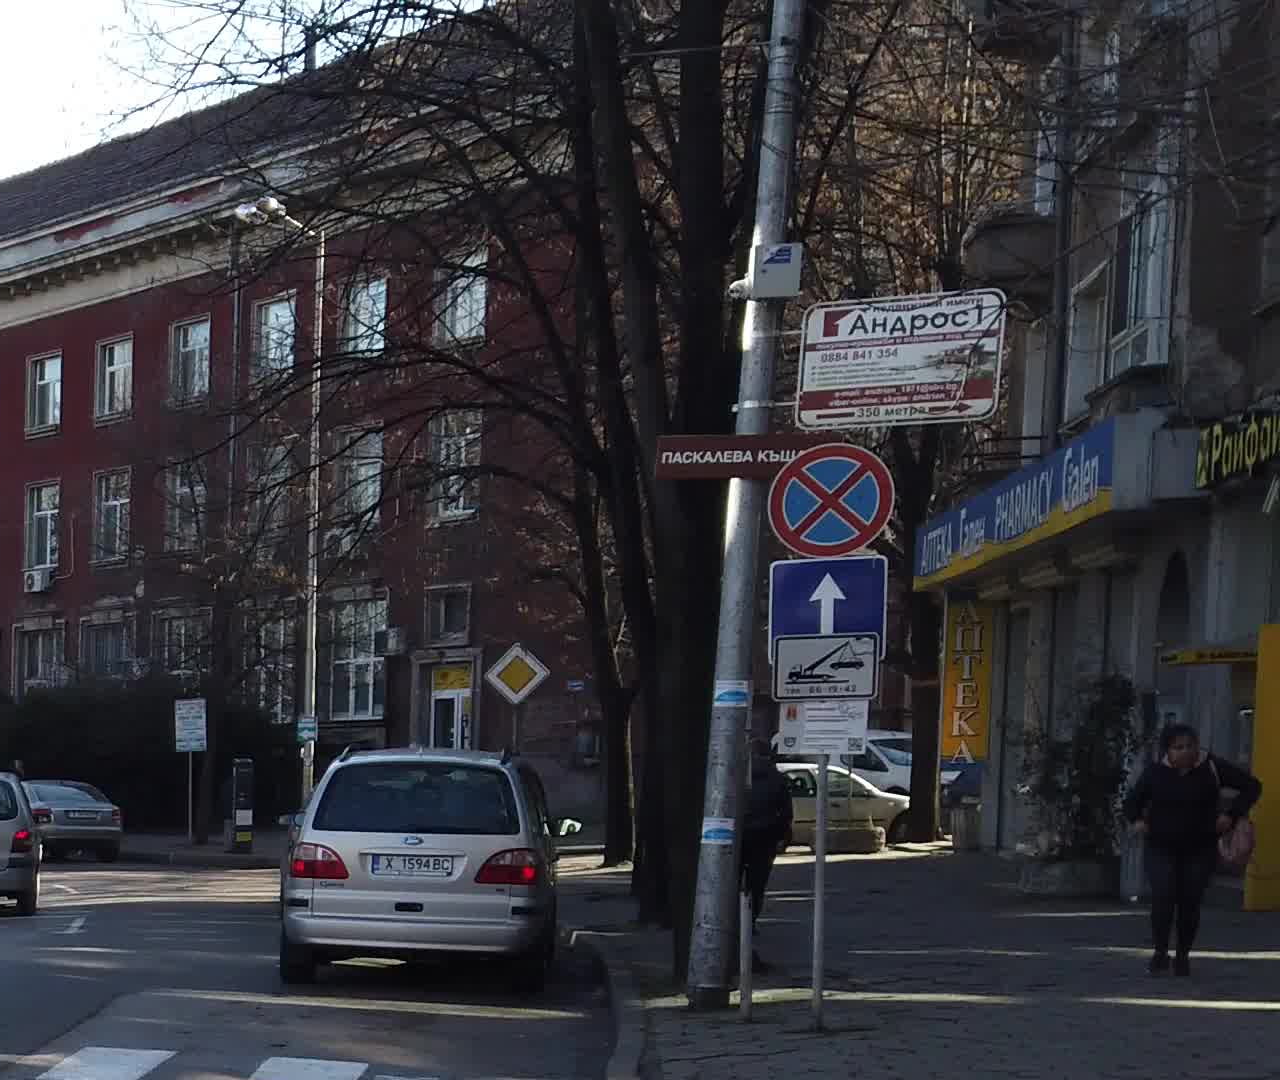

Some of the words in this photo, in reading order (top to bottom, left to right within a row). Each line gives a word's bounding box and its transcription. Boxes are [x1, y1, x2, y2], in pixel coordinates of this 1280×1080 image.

[877, 347, 898, 360] 354
[857, 407, 880, 418] 350
[885, 404, 928, 418] метра
[661, 451, 753, 464] ПАСКАЛЕВА
[994, 466, 1054, 543] PHARMACY
[1061, 444, 1100, 513] Galen
[952, 601, 984, 763] АПТЕКА
